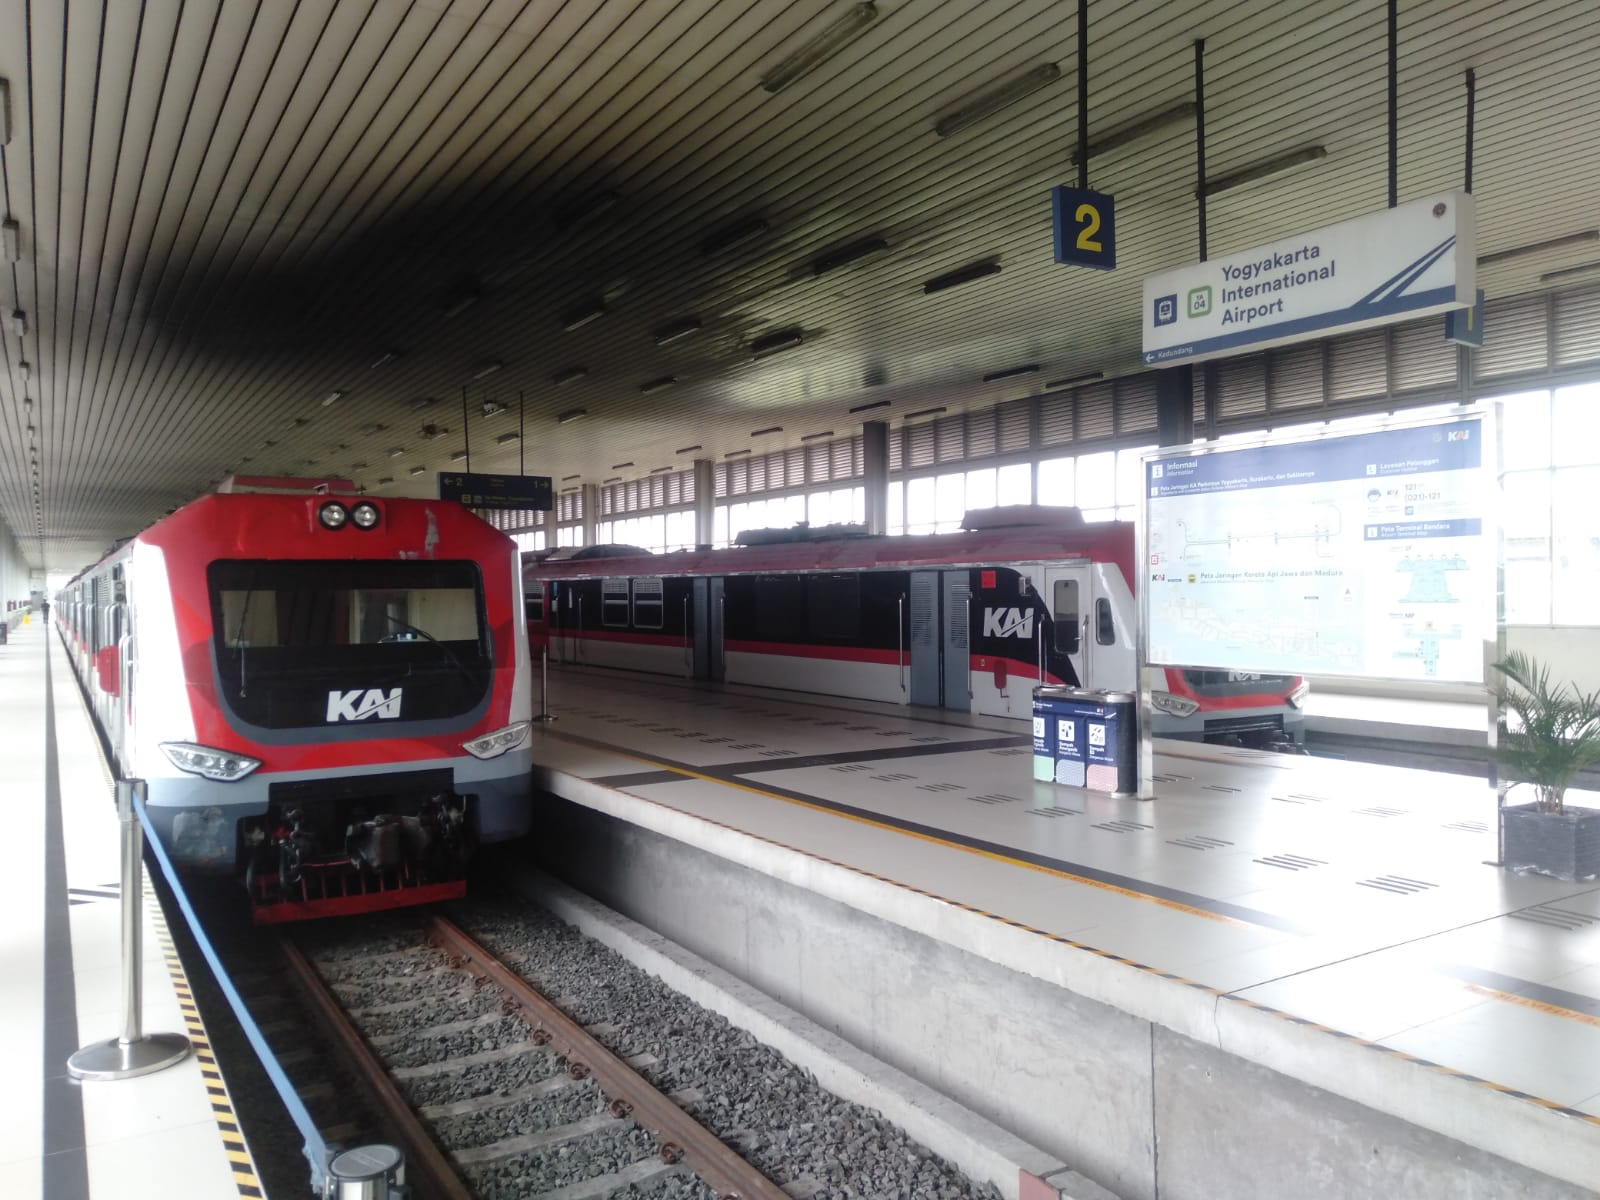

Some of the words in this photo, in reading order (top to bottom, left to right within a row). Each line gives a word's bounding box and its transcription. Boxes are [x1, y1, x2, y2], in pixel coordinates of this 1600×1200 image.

[1075, 204, 1102, 252] 2
[1222, 246, 1320, 281] Yogyakarta
[1222, 260, 1335, 304] International
[1194, 300, 1205, 310] 04
[1221, 298, 1284, 325] Airport
[1158, 346, 1193, 358] Kedundang
[1167, 458, 1198, 470] Informasi
[1267, 571, 1279, 579] Api
[1314, 569, 1343, 577] Madura
[983, 607, 1035, 639] KAI
[326, 688, 402, 722] KAI
